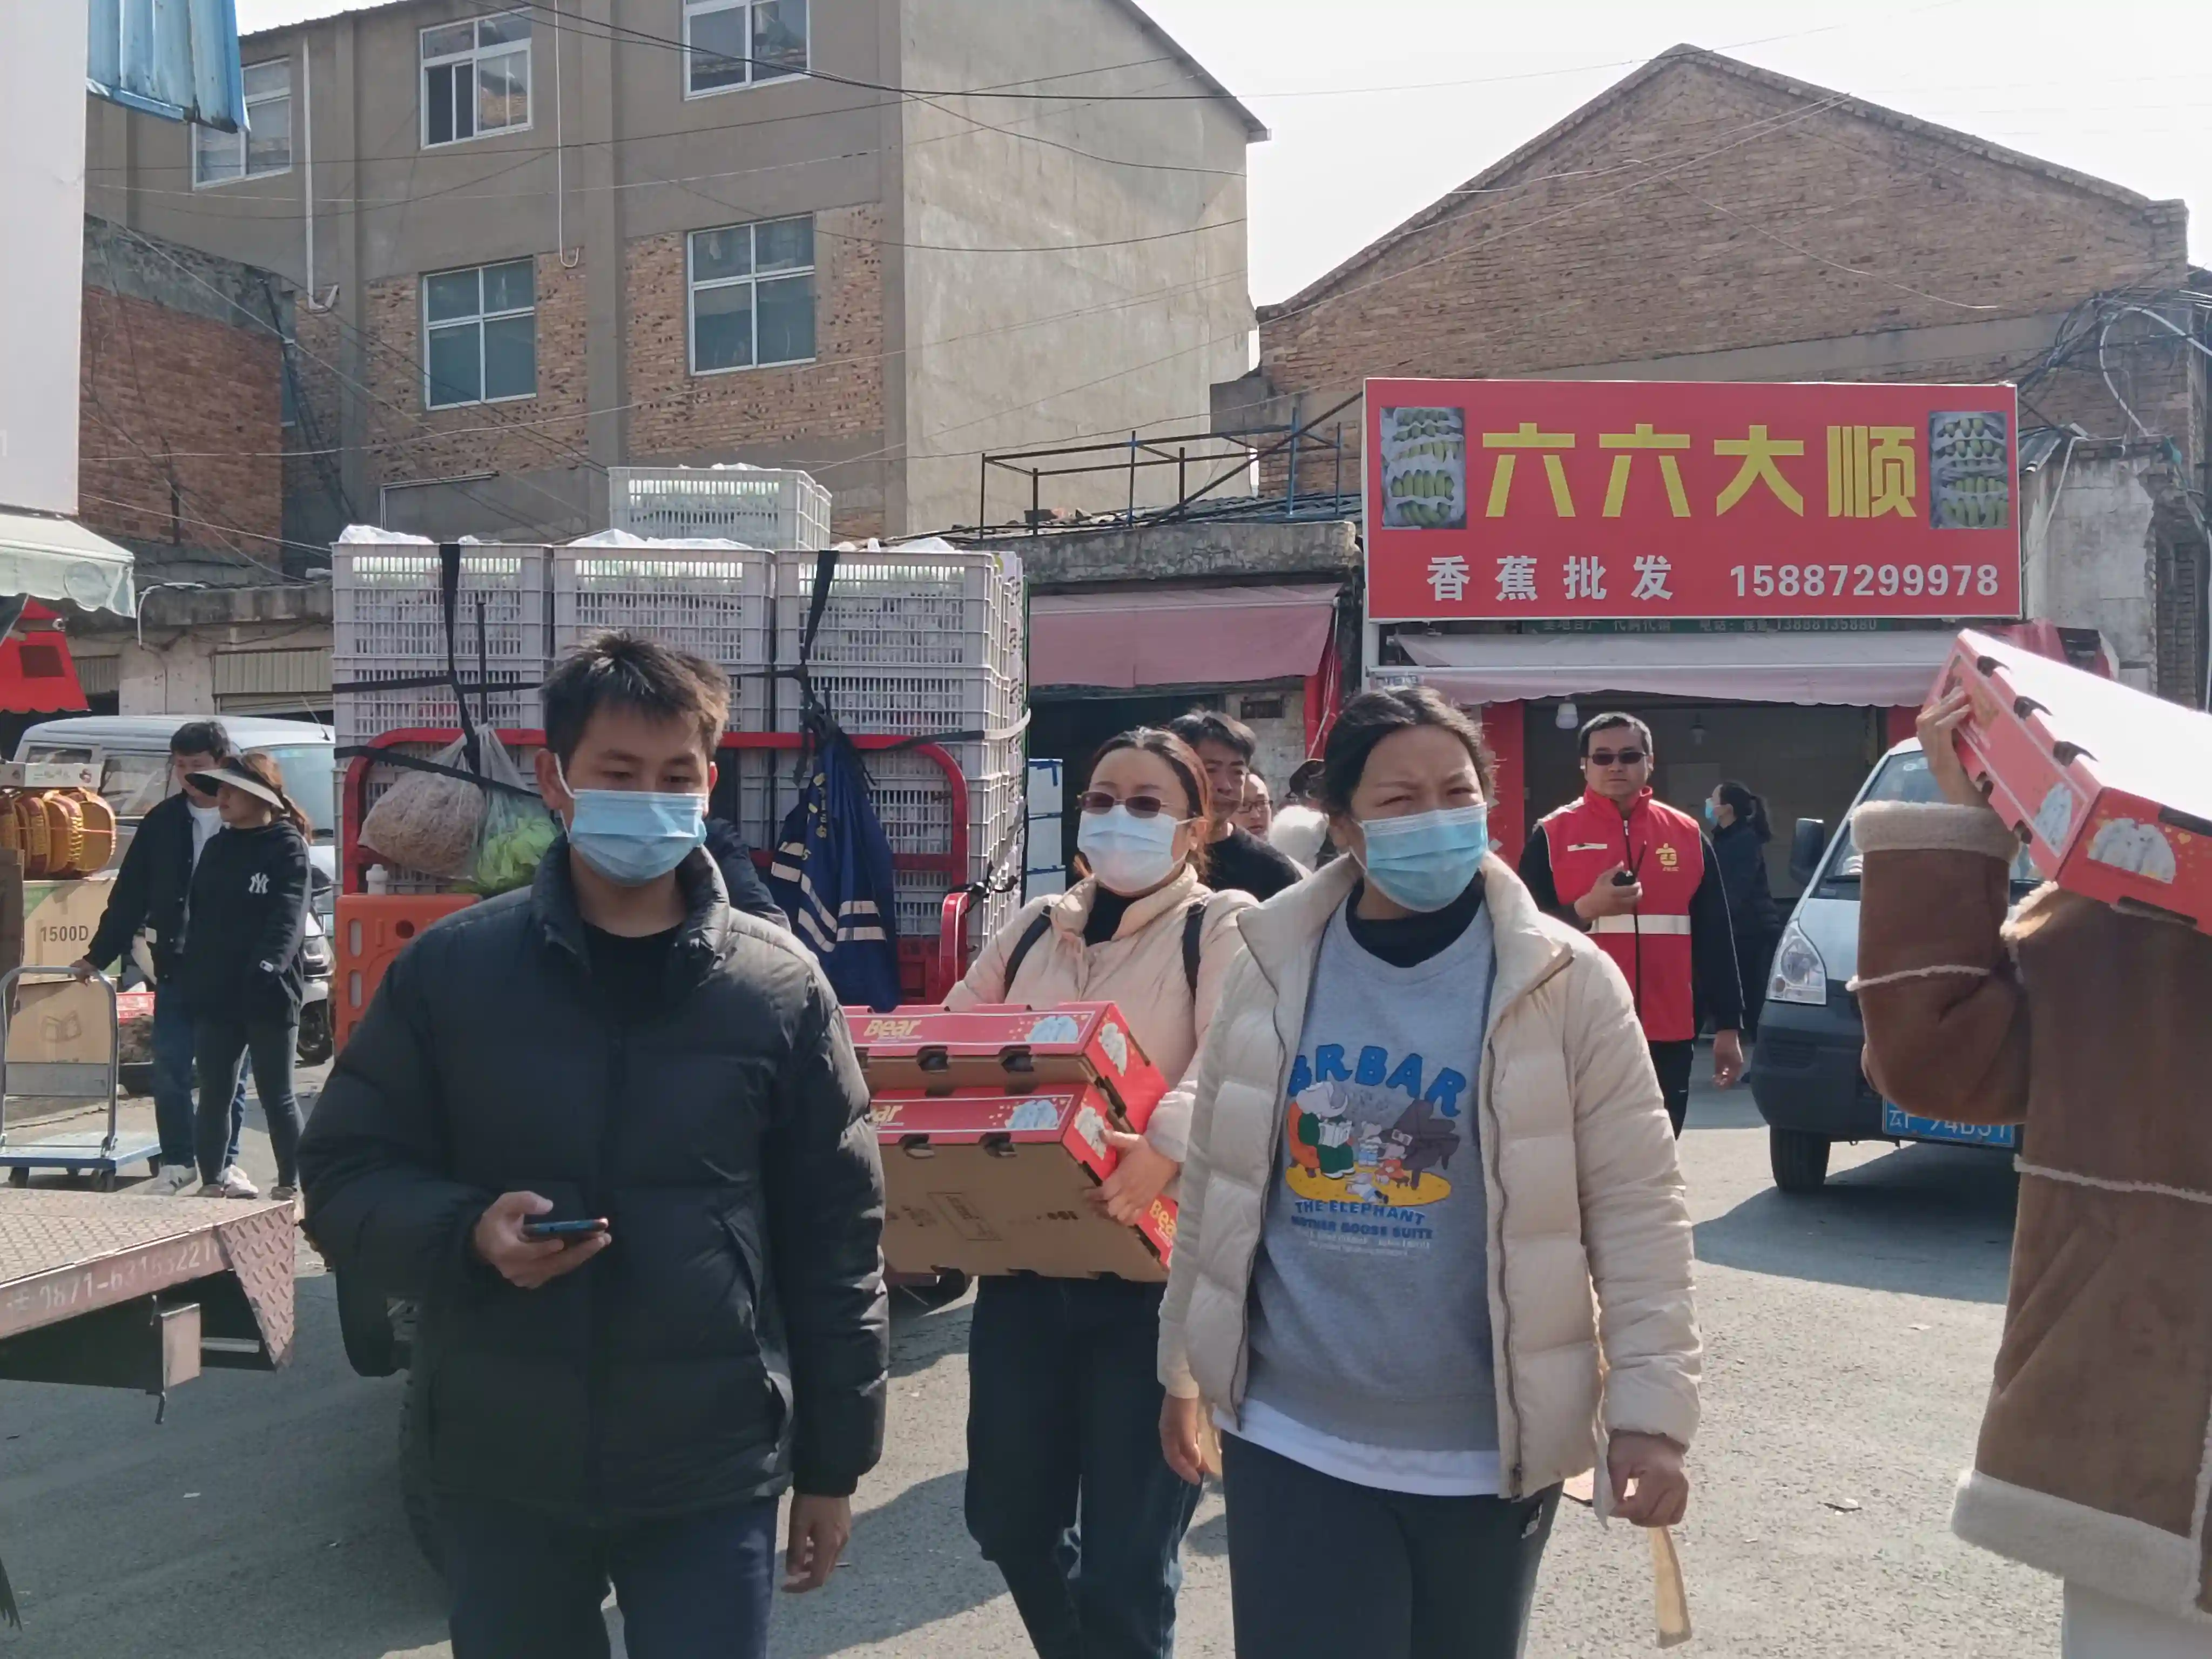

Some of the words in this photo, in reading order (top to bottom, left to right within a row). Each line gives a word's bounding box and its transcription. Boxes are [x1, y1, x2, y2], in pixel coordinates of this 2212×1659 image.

[1482, 421, 1917, 518] 六六大顺
[1426, 554, 1674, 602] 香蕉批发
[1730, 563, 1999, 598] 15887299978
[40, 925, 89, 942] 1500D
[864, 1019, 922, 1037] Bear
[1295, 1201, 1323, 1213] THE
[1330, 1200, 1425, 1225] ELEPHANT
